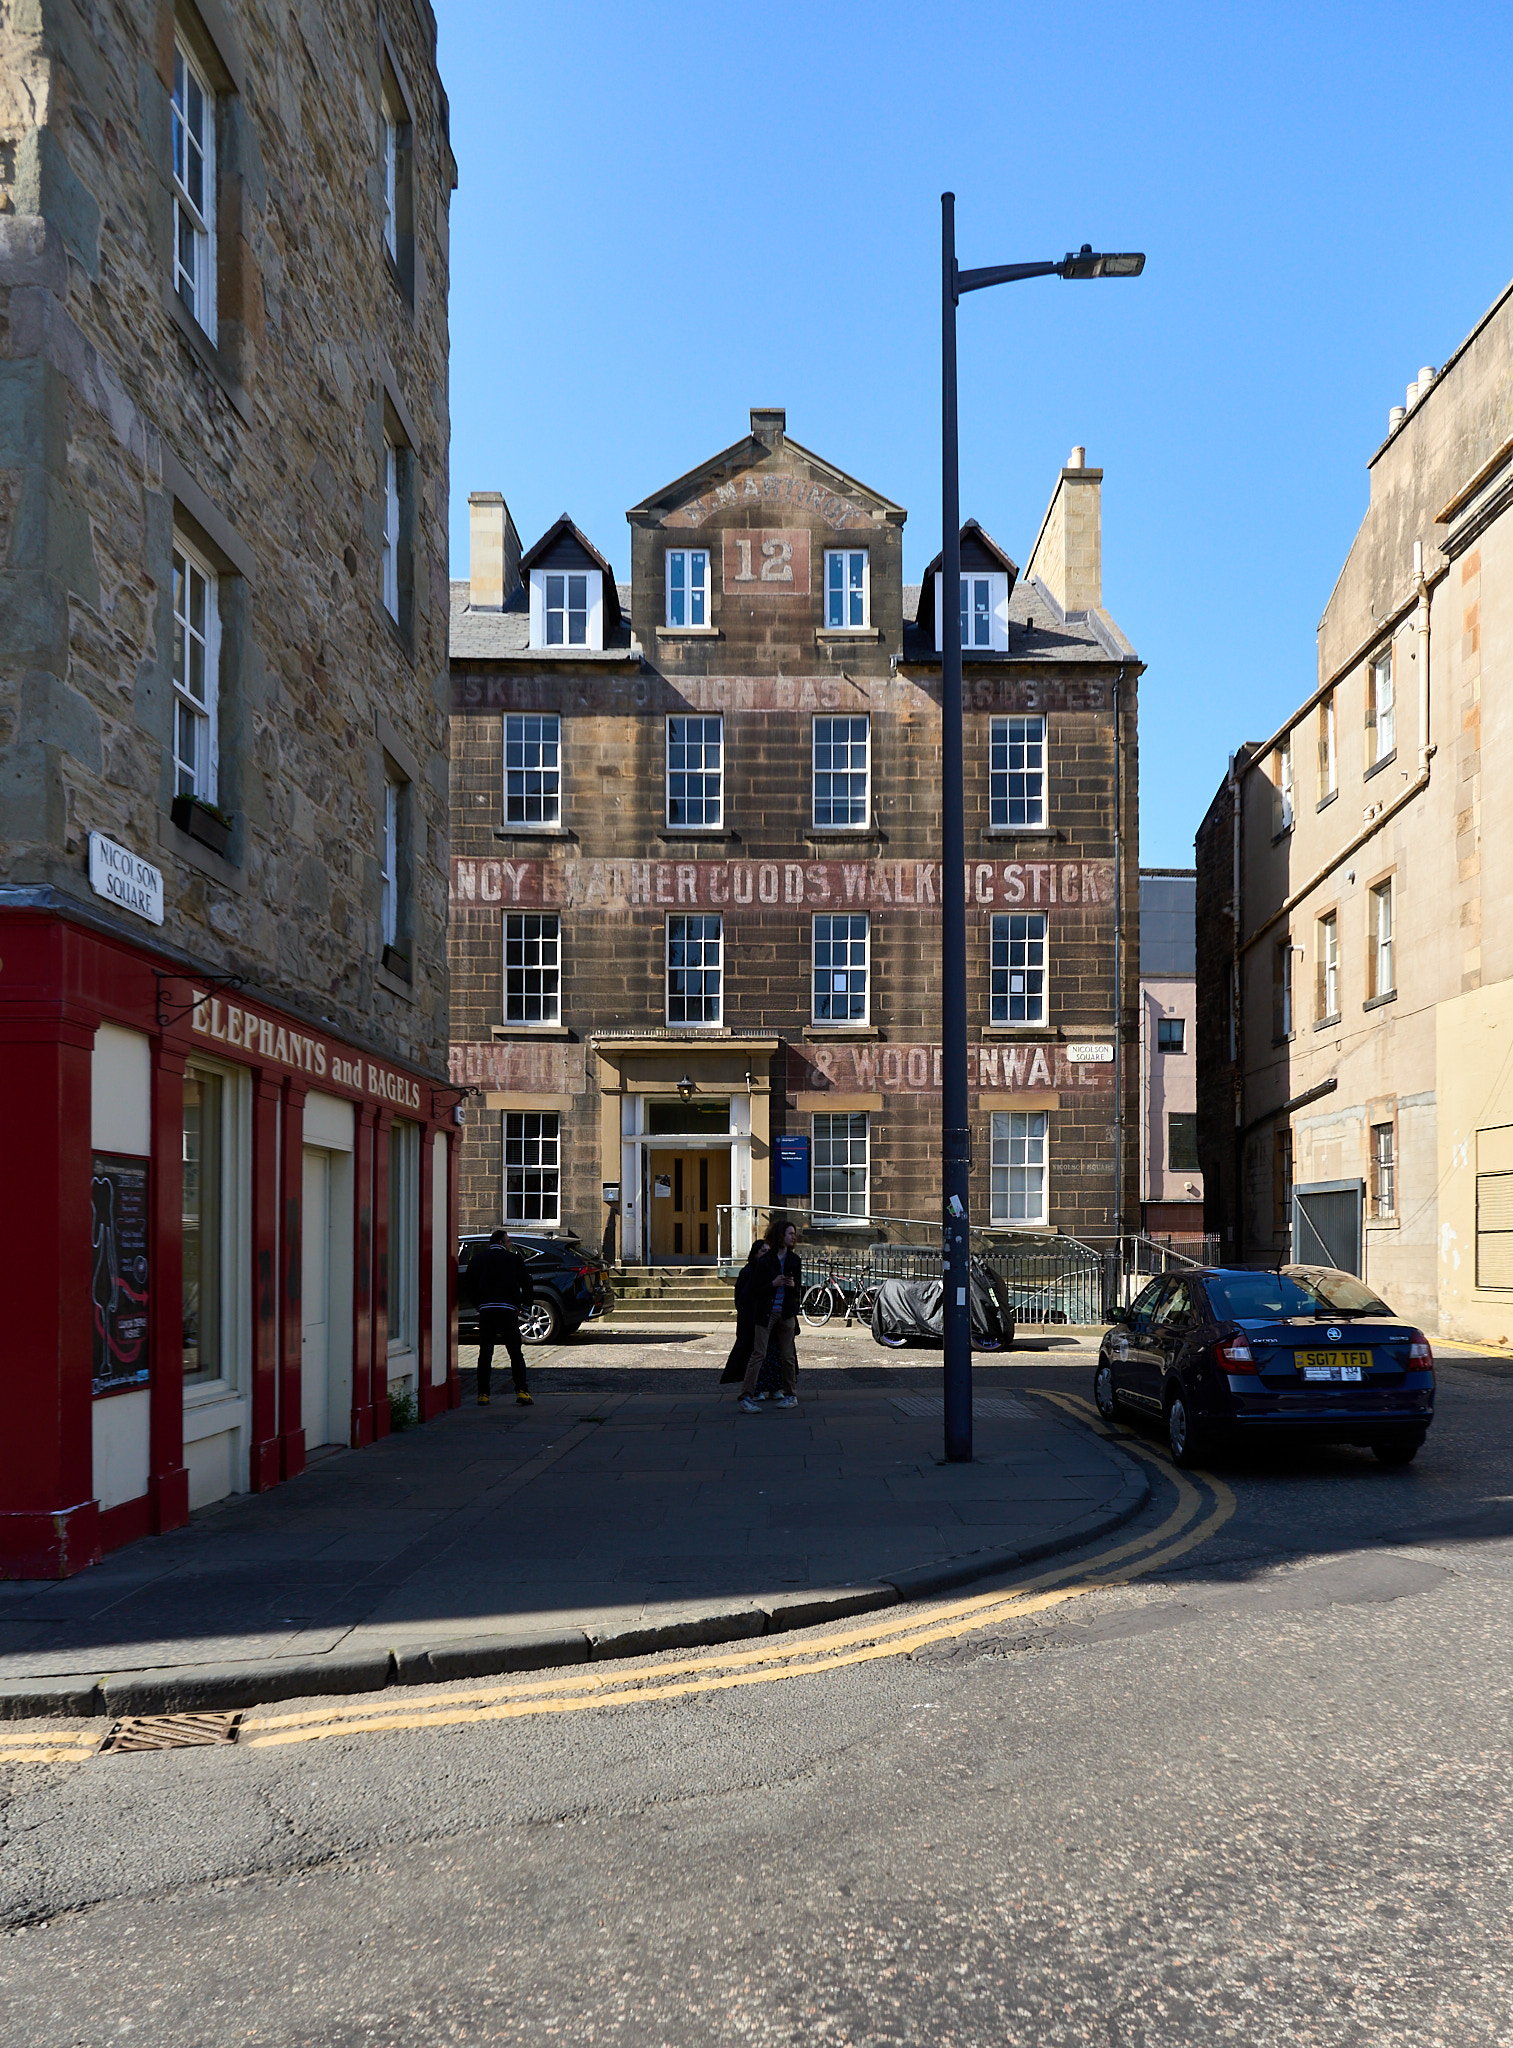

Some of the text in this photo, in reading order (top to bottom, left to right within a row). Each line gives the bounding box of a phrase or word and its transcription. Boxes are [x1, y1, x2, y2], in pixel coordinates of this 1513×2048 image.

[734, 538, 794, 582] 12
[100, 840, 158, 893] NICOLSON
[107, 873, 152, 915] SQUARE
[191, 989, 328, 1078] ELEPHANTS
[331, 1055, 363, 1090] and
[368, 1063, 421, 1111] BAGELS
[1307, 1352, 1368, 1366] SG17 TFD
